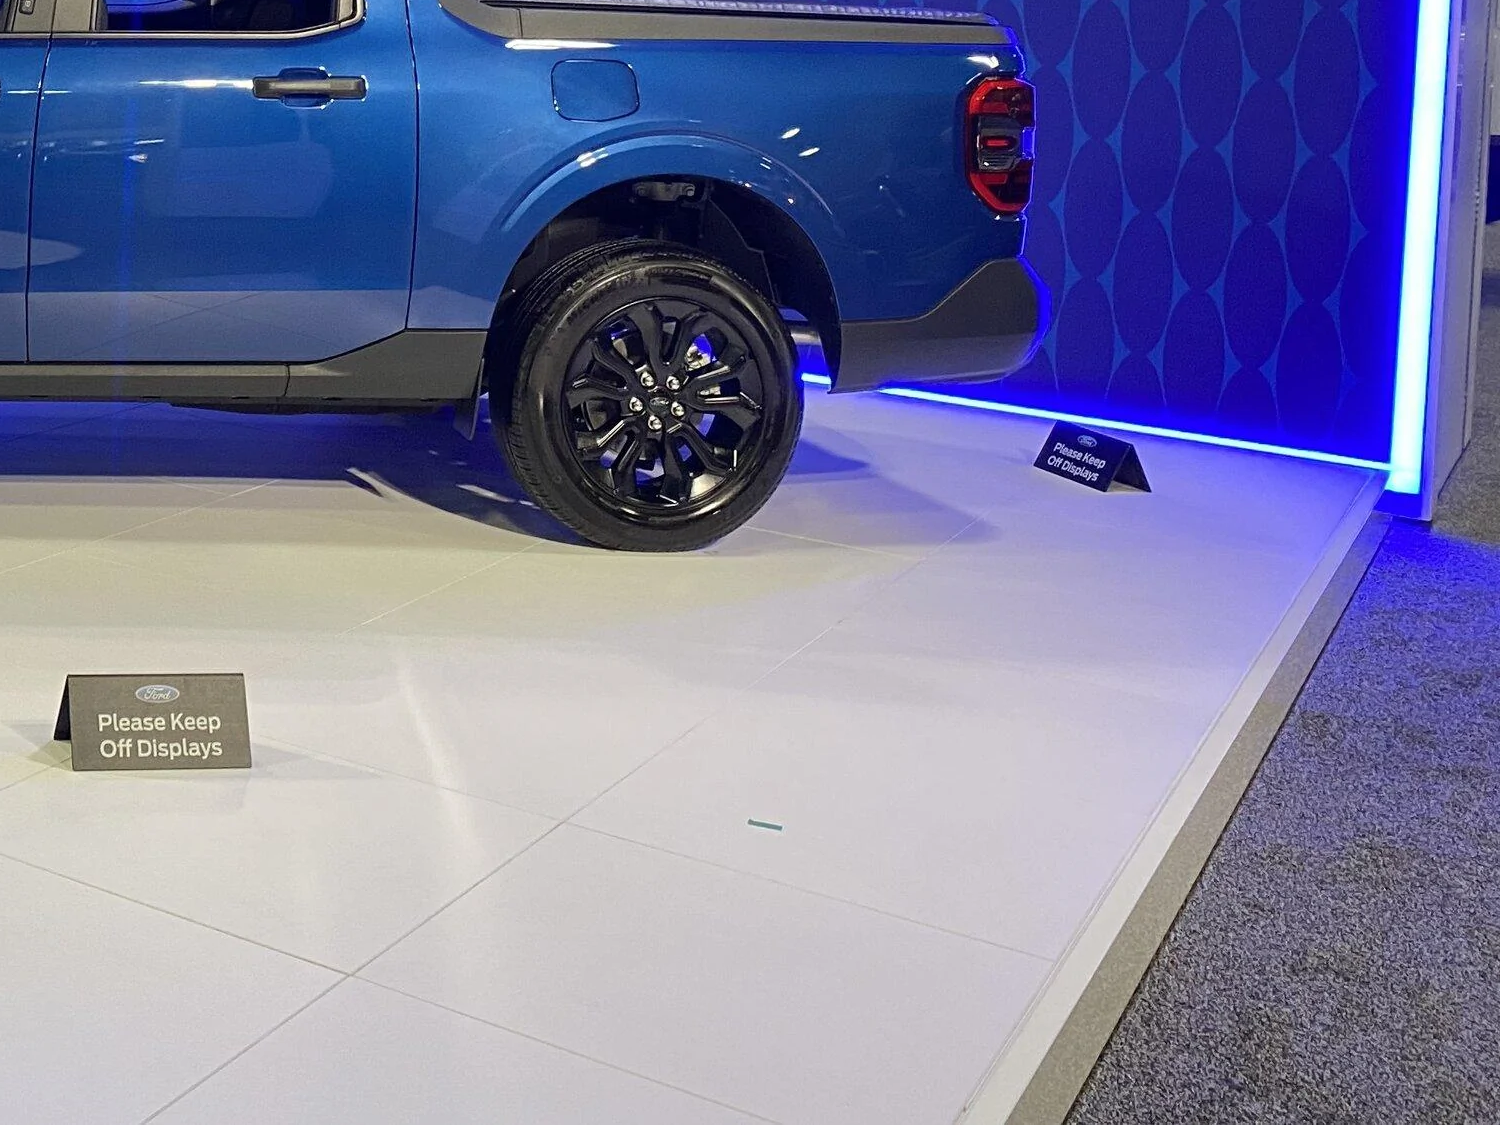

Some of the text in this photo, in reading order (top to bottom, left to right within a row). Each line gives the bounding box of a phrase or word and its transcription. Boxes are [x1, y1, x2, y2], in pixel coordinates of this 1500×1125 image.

[1053, 442, 1107, 469] Please Keep
[1047, 455, 1099, 482] Off Displays
[143, 686, 172, 700] Ford
[97, 712, 222, 734] Please Keep
[99, 737, 224, 760] Off Displays
